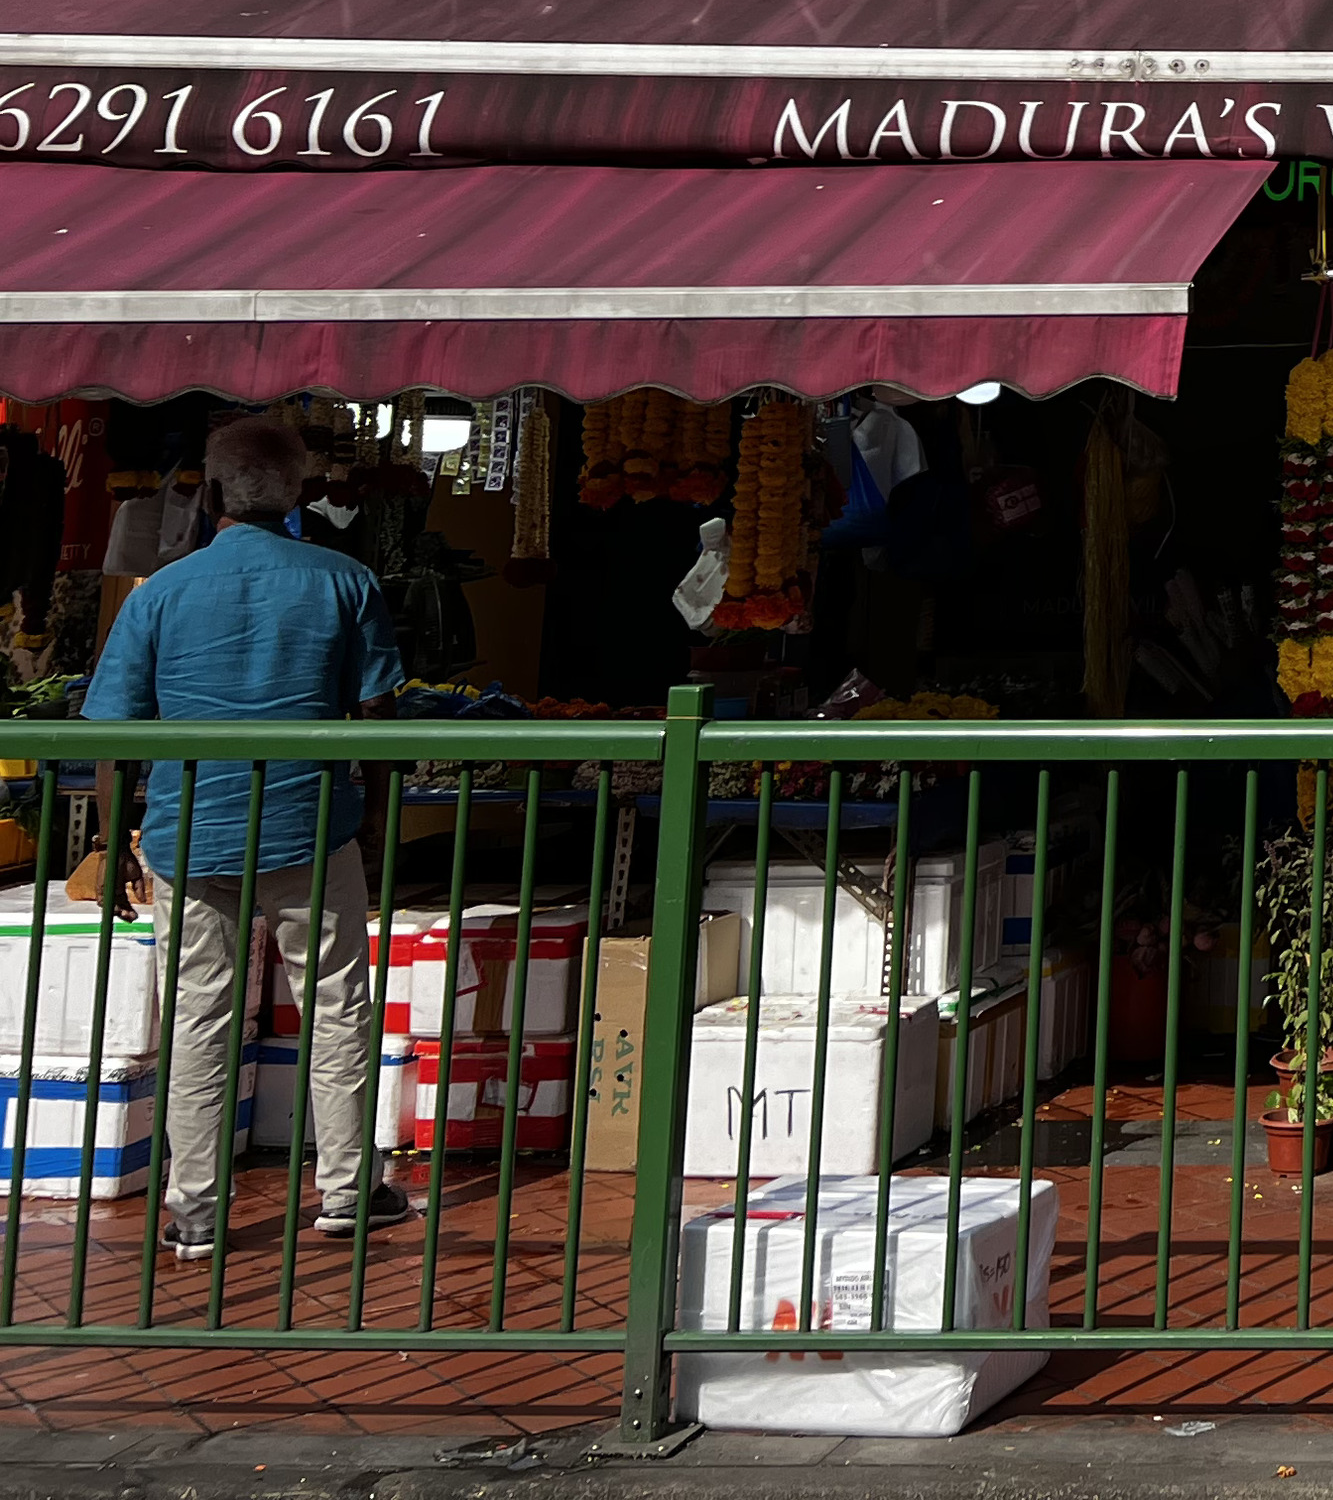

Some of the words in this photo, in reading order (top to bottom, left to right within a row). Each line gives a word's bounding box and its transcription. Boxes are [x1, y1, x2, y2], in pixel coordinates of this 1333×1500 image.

[0, 83, 193, 154] 6291
[232, 87, 445, 156] 6161
[772, 97, 1281, 161] MADURA'S
[727, 1085, 811, 1140] MT
